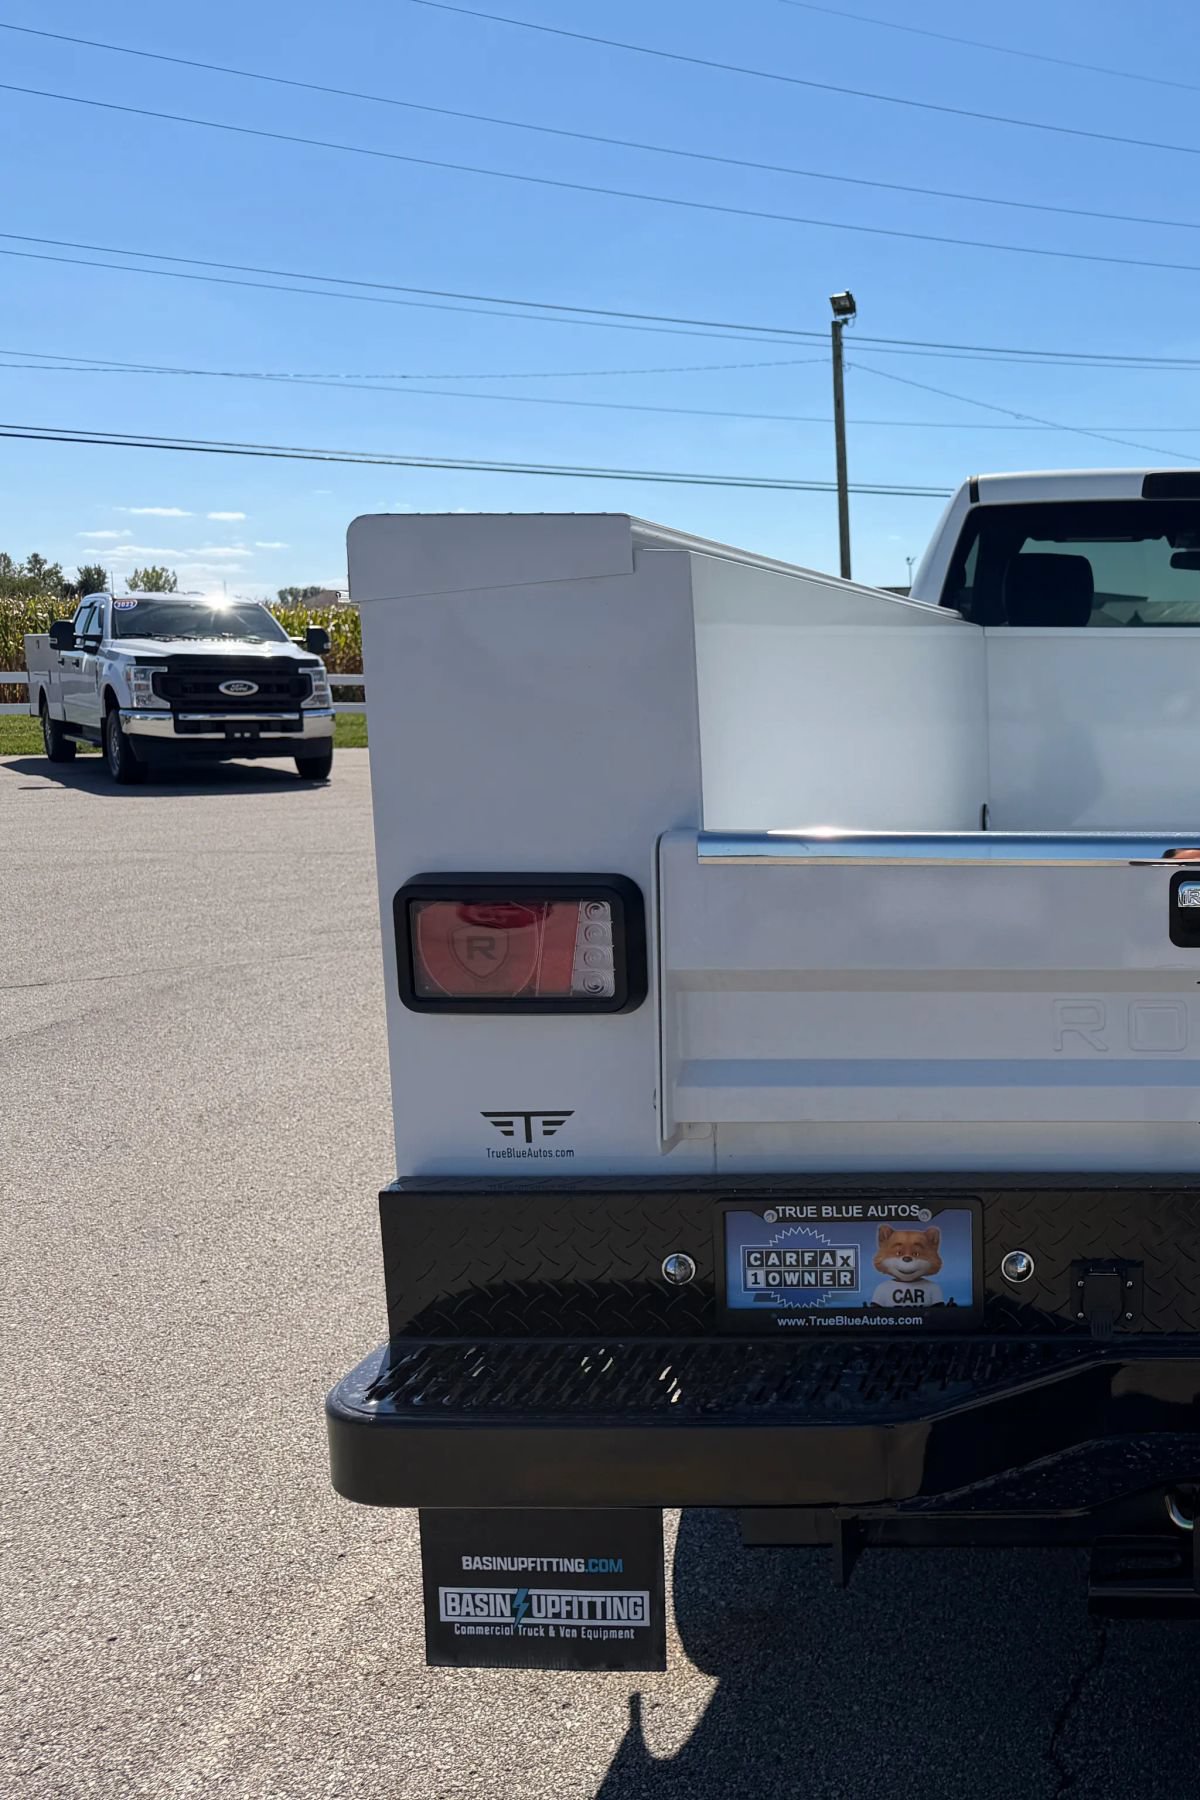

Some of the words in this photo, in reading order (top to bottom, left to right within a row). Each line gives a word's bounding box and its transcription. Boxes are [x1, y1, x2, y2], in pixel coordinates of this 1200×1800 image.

[466, 935, 497, 961] R
[487, 1148, 575, 1158] TrueBlueAutos.com
[776, 1206, 817, 1218] TRUE
[821, 1206, 863, 1218] BLUE
[867, 1205, 920, 1217] AUTOS
[749, 1251, 854, 1268] CARFAX
[750, 1273, 761, 1286] 1
[767, 1272, 852, 1286] OWNER
[892, 1289, 925, 1303] CAR
[777, 1315, 923, 1326] www.TrueBlueAutos.com
[461, 1556, 624, 1573] BASINUPFITTING.COM
[446, 1593, 511, 1617] BASIN
[531, 1595, 643, 1620] UPFITTING
[454, 1623, 514, 1636] Commercial
[518, 1624, 545, 1637] Truck
[549, 1626, 555, 1637] &
[559, 1626, 577, 1637] Van
[581, 1627, 635, 1640] Equipment
